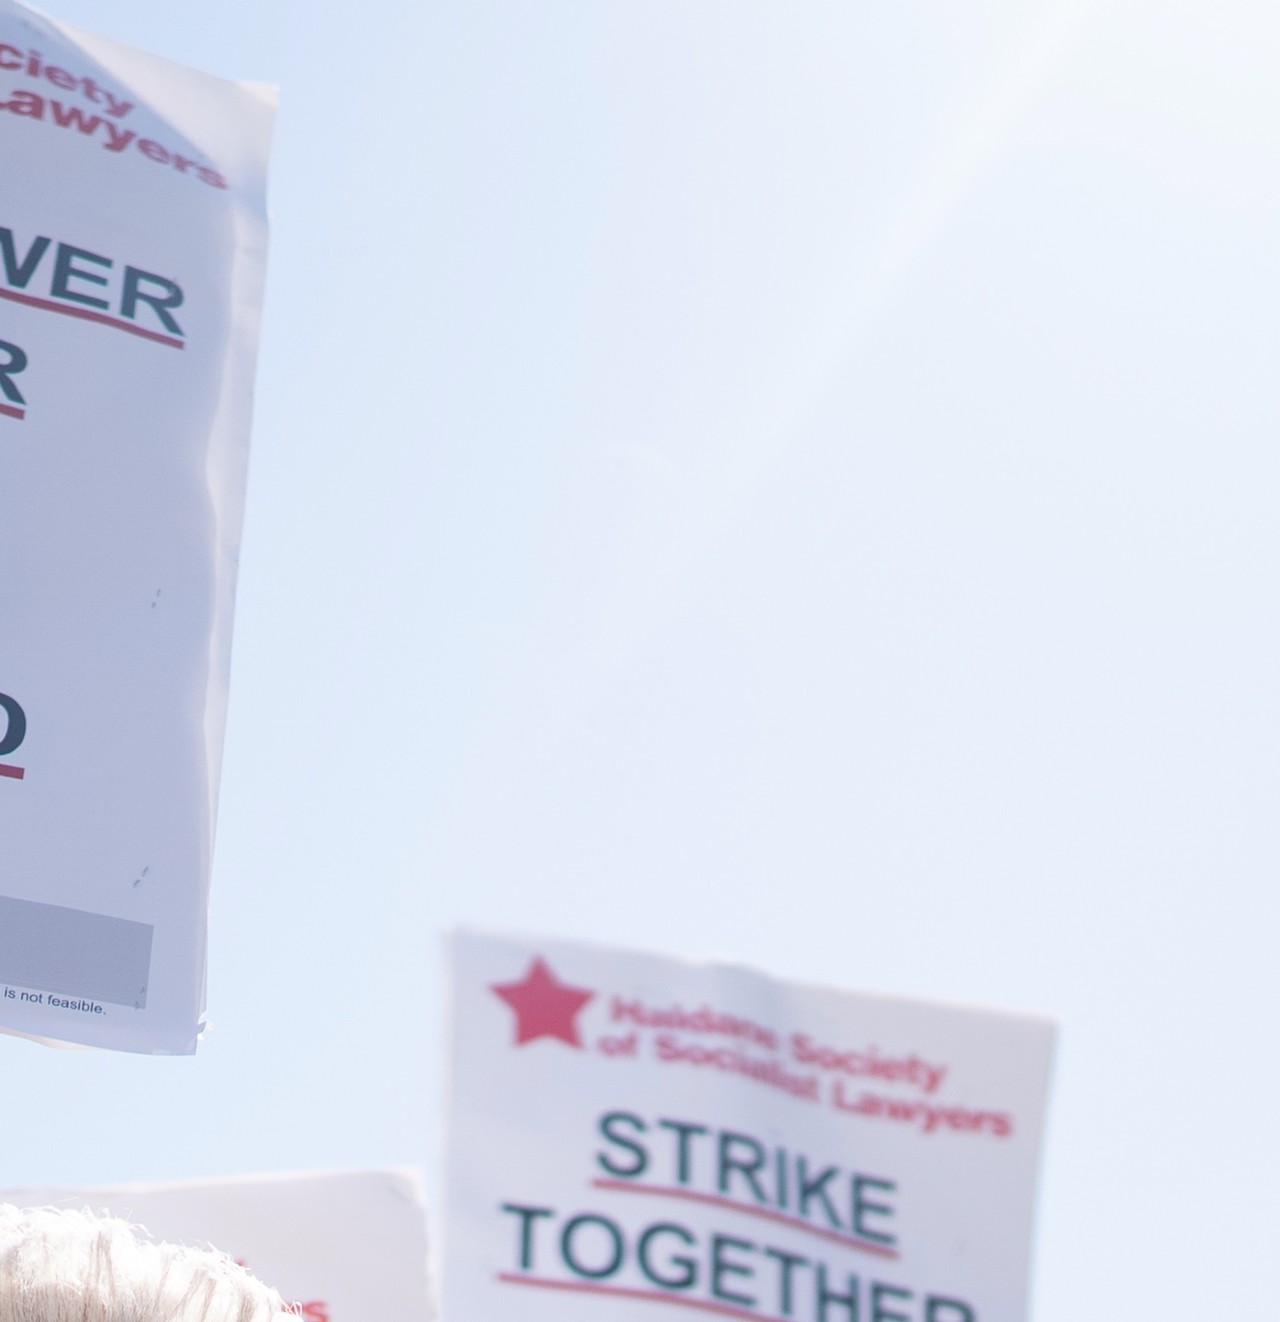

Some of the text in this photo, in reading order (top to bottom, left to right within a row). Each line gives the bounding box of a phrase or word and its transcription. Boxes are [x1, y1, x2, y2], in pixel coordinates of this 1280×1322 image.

[4, 986, 17, 1000] is
[20, 989, 44, 1004] not
[47, 994, 107, 1015] feasible.
[594, 1110, 900, 1246] STRIKE
